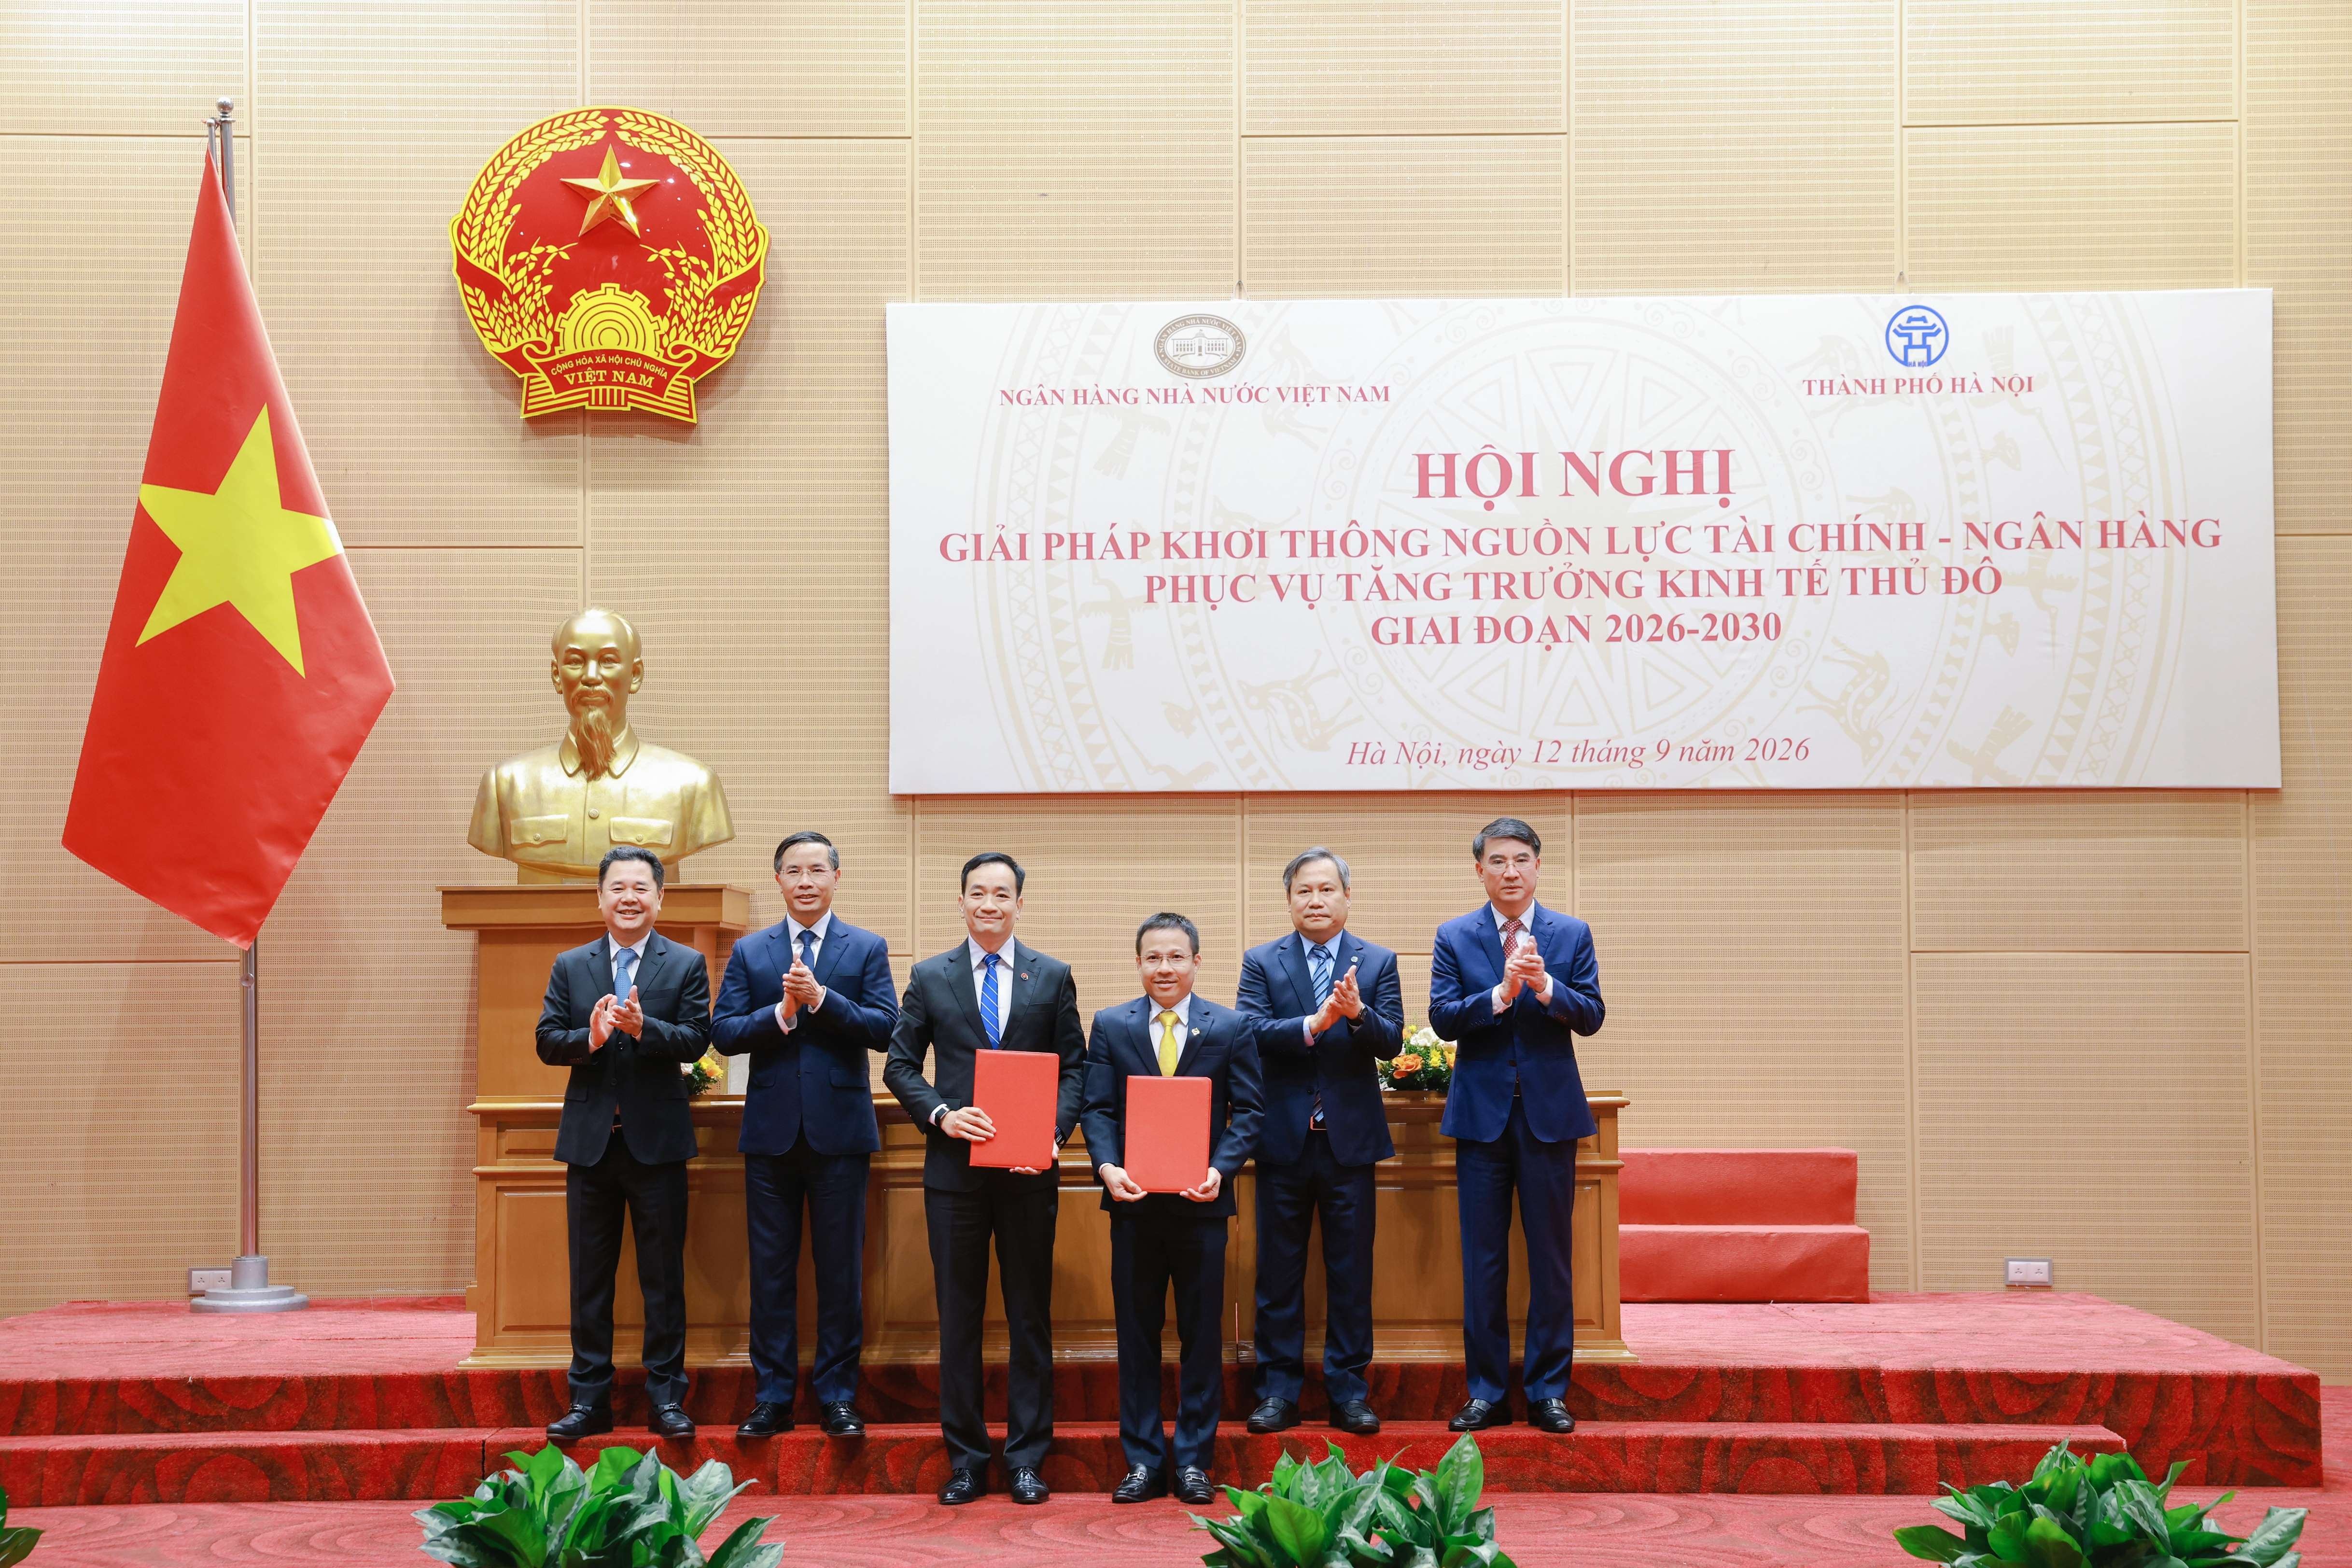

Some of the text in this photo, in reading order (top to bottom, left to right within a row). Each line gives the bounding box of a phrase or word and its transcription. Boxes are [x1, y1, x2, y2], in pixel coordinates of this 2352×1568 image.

[551, 354, 667, 379] CỘNG HÒA XÃ HỘI CHỦ NGHĨA
[564, 367, 655, 388] VIỆT NAM
[1163, 358, 1181, 372] STATE
[1210, 357, 1237, 374] VIETNAM
[1000, 382, 1389, 407] NGÂN HÀNG NHÀ NƯỚC VIỆT NAM
[1802, 372, 2033, 398] THÀNH PHỐ HÀ NỘI
[1414, 444, 1735, 512] HỘI NGHỊ
[939, 524, 1030, 562] GIẢI
[1043, 522, 1151, 561] PHÁP
[1162, 528, 1268, 560] KHƠI
[1280, 519, 1429, 559] THÔNG
[1442, 518, 1591, 557] NGUỒN
[1607, 521, 1692, 563] LỰC
[1704, 515, 1776, 554] TÀI
[1788, 513, 1927, 553] CHÍNH
[1964, 510, 2084, 550] NGÂN
[2098, 509, 2222, 549] HÀNG
[1145, 556, 2003, 611] PHỤC VỤ TĂNG TRƯỞNG KINH TẾ THỦ ĐÔ
[1371, 612, 1782, 653] GIAI ĐOẠN 2026-2030
[1347, 737, 1810, 770] Hà Nội, ngày 12 tháng 9 năm 2026
